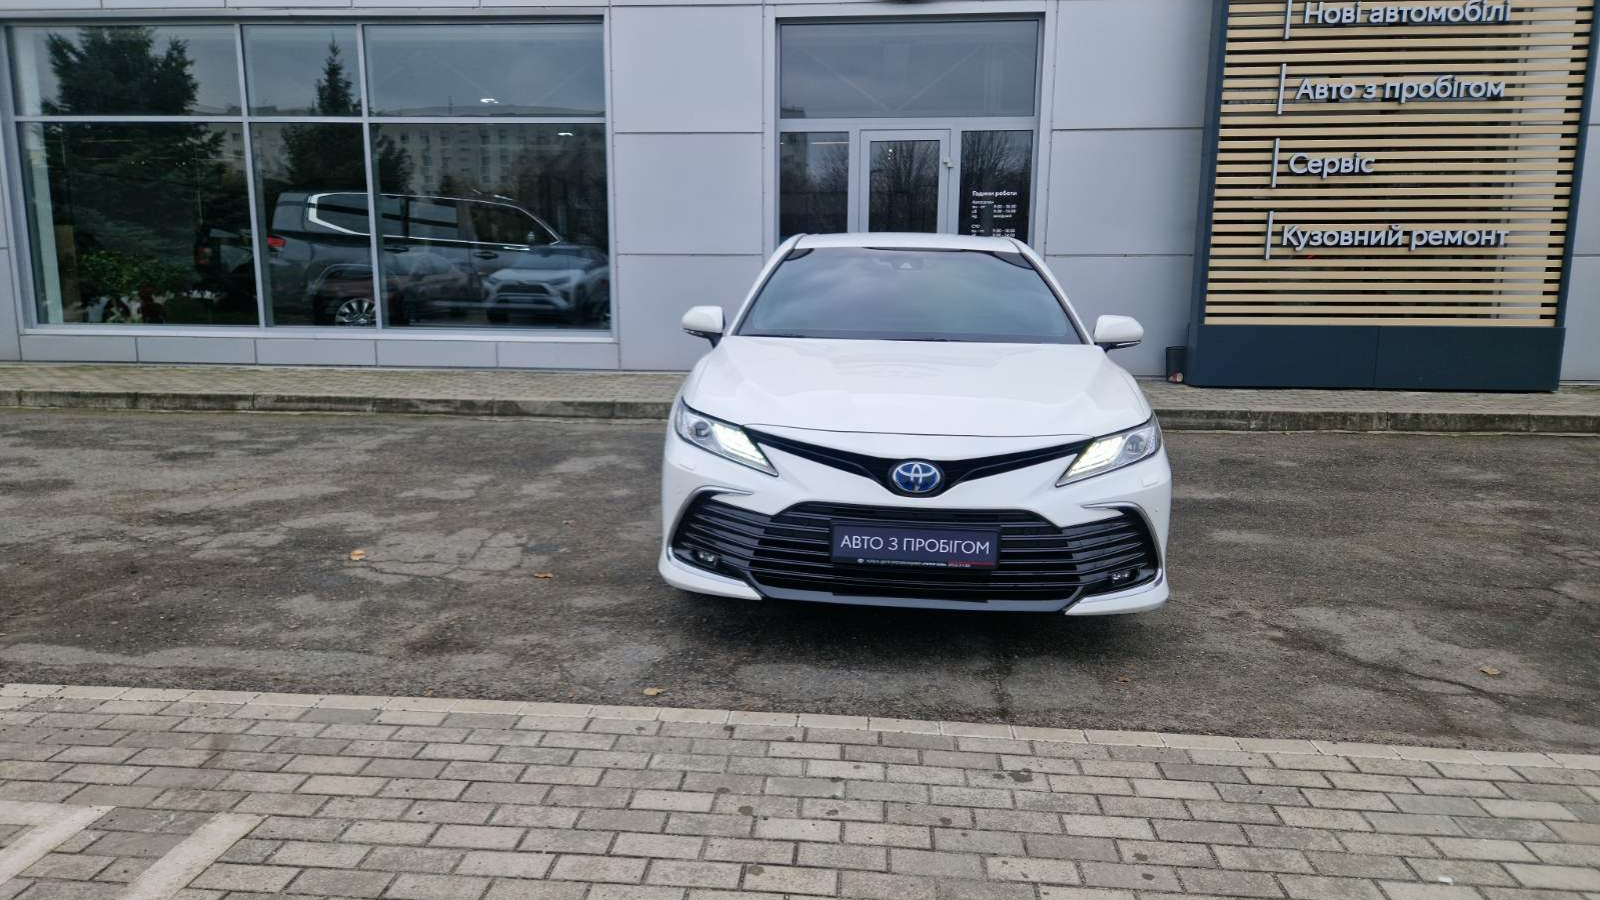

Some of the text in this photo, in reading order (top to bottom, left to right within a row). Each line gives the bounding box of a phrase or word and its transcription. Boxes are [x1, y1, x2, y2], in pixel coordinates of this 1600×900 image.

[1304, 0, 1511, 24] Нові автомобілі
[1295, 75, 1505, 103] Авто з пробігом
[1289, 153, 1376, 179] Сервіс
[1282, 224, 1510, 251] Кузовний ремонт
[840, 534, 884, 551] АВТО
[903, 537, 990, 555] ПРОБІГОМ
